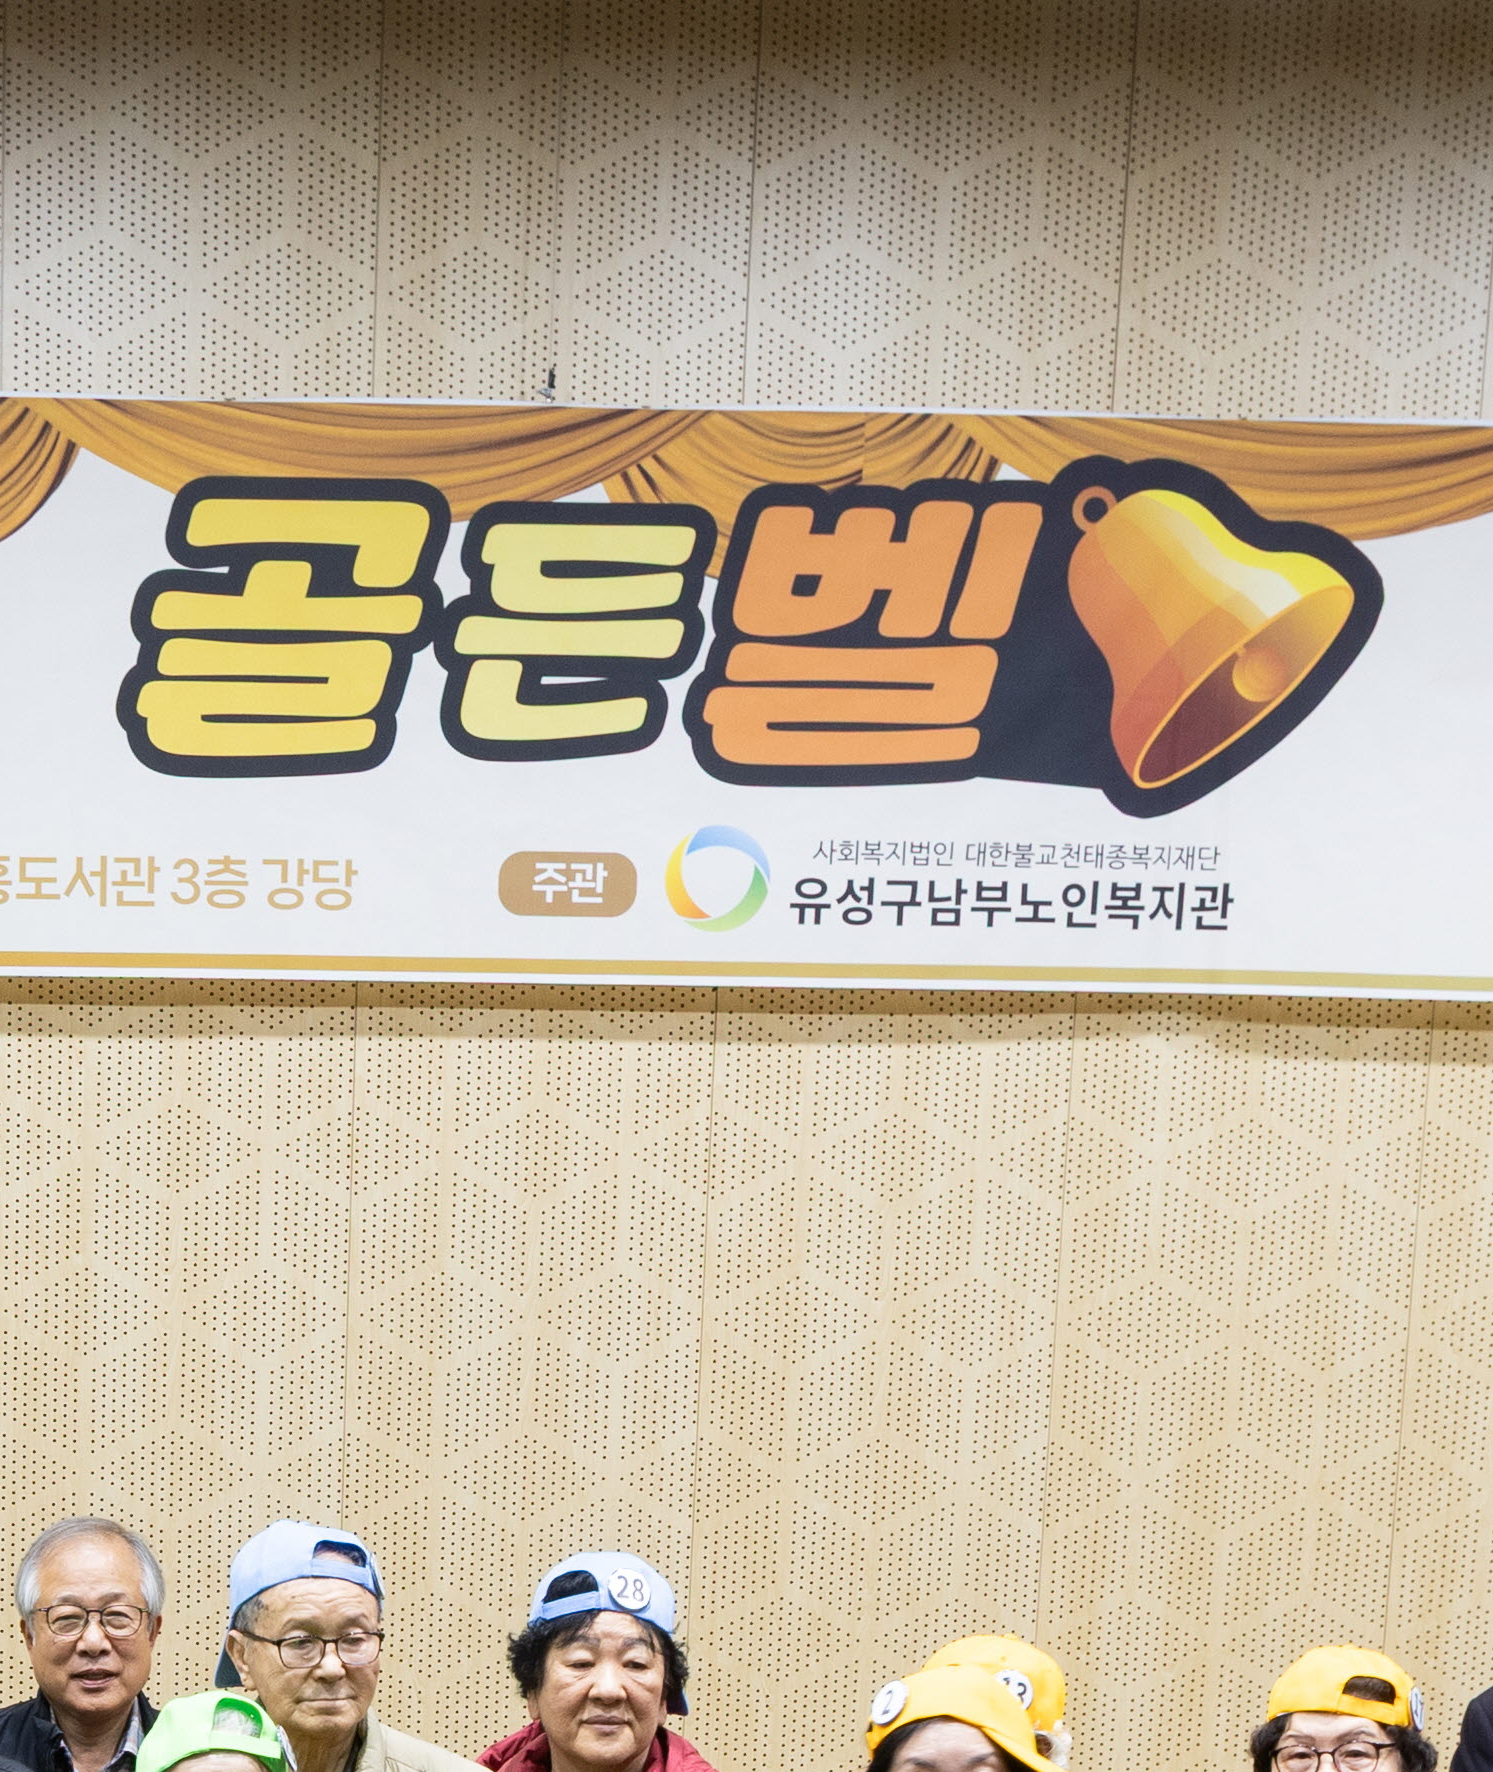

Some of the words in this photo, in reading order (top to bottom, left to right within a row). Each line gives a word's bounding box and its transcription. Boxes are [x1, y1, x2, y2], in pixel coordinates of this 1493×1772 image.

[117, 476, 1047, 788] 골든벨
[812, 840, 957, 868] 사회복지법인
[964, 841, 1221, 873] 대한불교천태종복지재단
[170, 856, 249, 909] 3층
[263, 857, 358, 911] 강당
[531, 861, 608, 904] 주관
[789, 877, 1234, 931] 유성구남부노인복지관
[616, 1575, 644, 1603] 28
